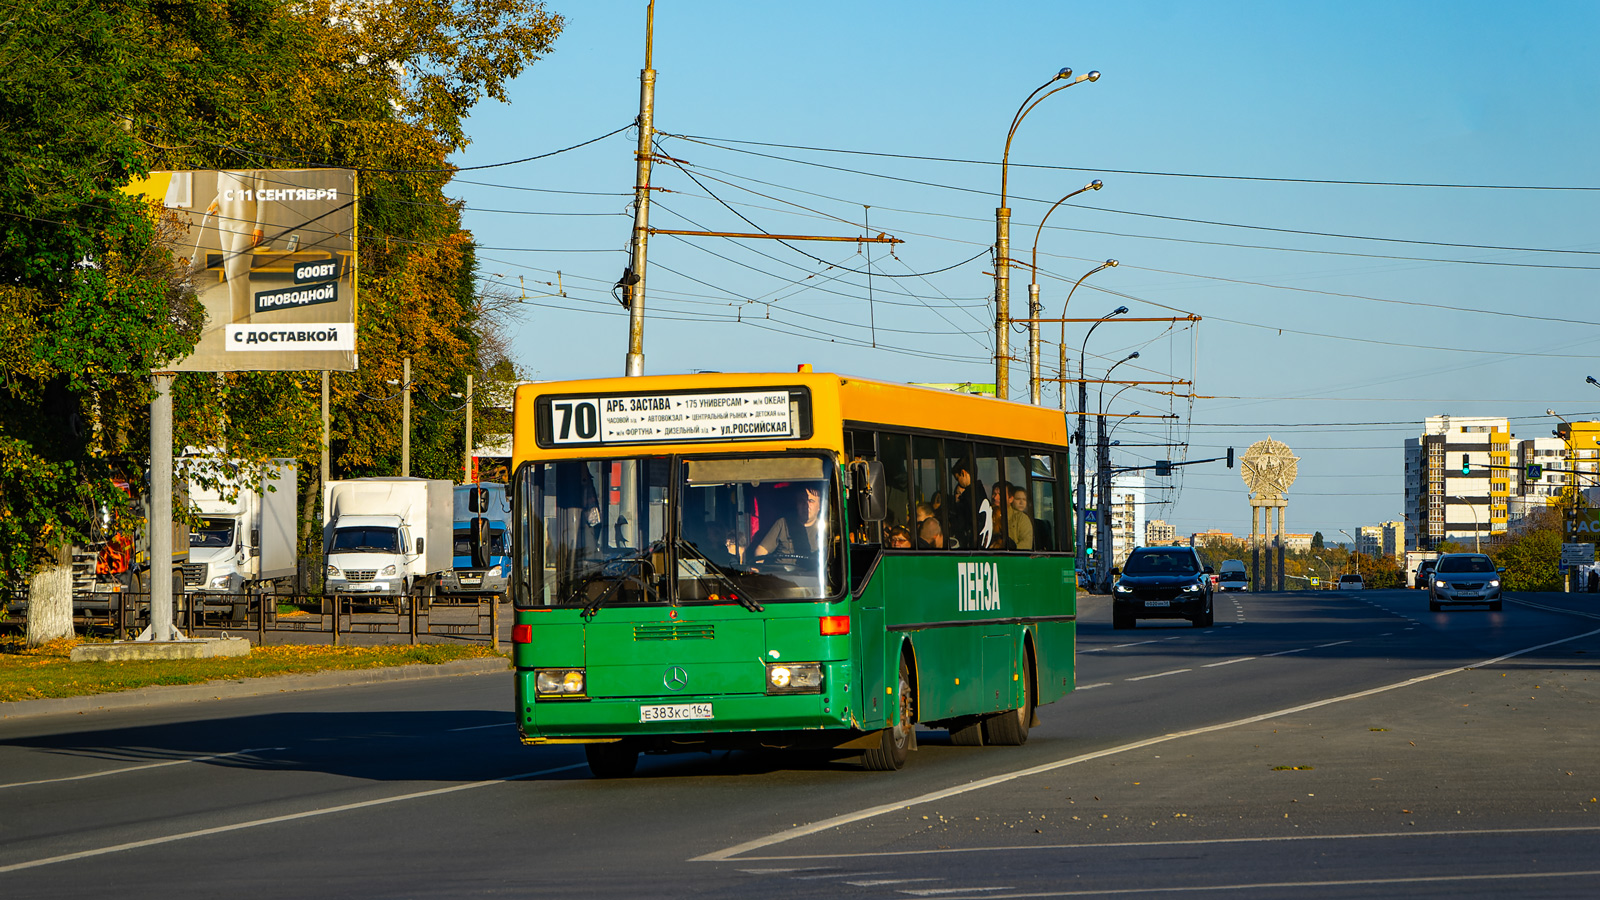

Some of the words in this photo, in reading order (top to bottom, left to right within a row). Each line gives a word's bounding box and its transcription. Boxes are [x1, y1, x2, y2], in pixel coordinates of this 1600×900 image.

[224, 189, 235, 201] С
[236, 189, 253, 201] 11
[255, 188, 337, 201] СЕНТЯБРЯ
[296, 263, 336, 280] 600ВТ
[259, 284, 334, 307] ПРОВОДНОЙ
[233, 331, 243, 342] С
[246, 327, 338, 344] ДОСТАВКОЙ
[606, 399, 628, 412] АРБ.
[630, 397, 671, 412] ЗАСТАВА
[685, 399, 698, 408] 175
[699, 397, 742, 408] УНИВЕРСАМ
[764, 396, 786, 405] ОКЕАН
[554, 401, 597, 440] 70
[606, 416, 630, 424] ЧАСОВОЙ
[648, 413, 683, 423] АВТОВОКЗАЛ
[691, 411, 729, 421] ЦЕНТРАЛЬНЫЙ
[729, 411, 748, 419] РЫНОК
[755, 410, 777, 418] ДЕТСКАЯ
[625, 427, 653, 436] ФОРТУНА
[664, 424, 700, 436] ДИЗЕЛЬНЫЙ
[957, 561, 1001, 612] ПЕНЗА
